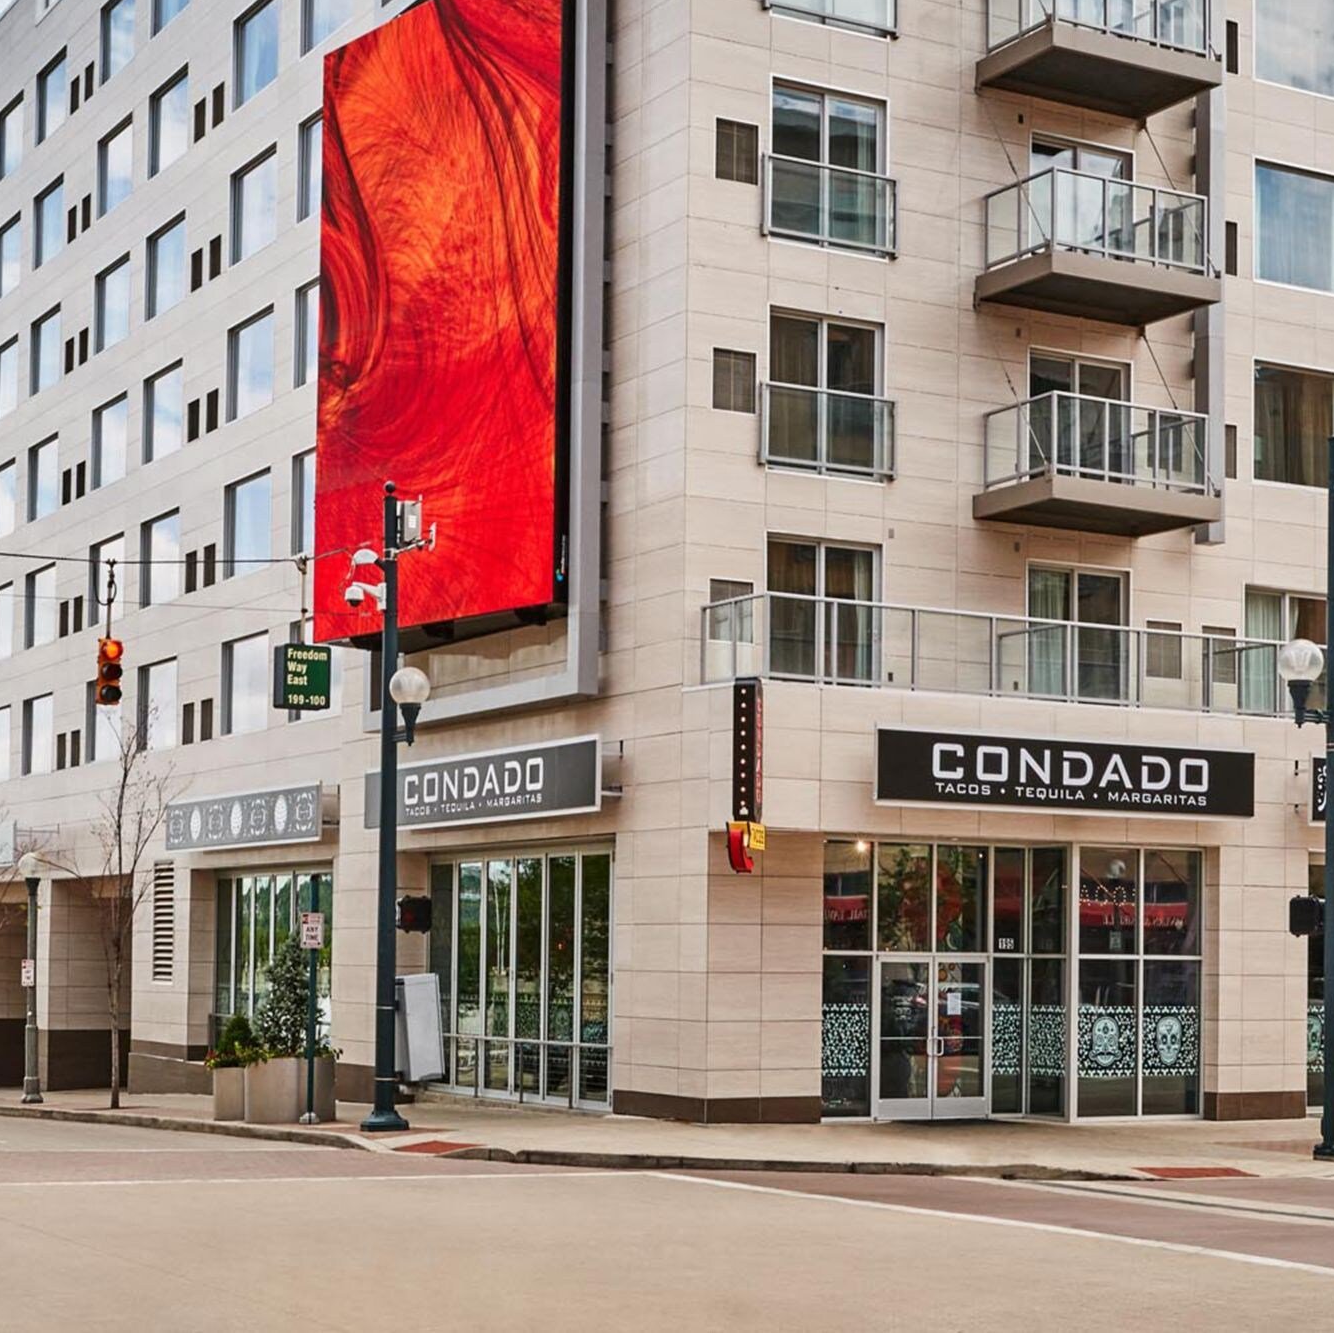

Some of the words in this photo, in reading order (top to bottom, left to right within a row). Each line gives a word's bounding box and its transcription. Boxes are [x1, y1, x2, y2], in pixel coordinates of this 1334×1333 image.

[287, 648, 328, 661] Freedom
[287, 661, 307, 674] Way
[287, 673, 308, 686] East
[288, 694, 326, 705] 199-100
[932, 742, 1209, 793] CONDADO
[404, 757, 544, 805] CONDADO
[935, 782, 991, 796] TACOS
[1015, 786, 1085, 801] TEQUILA
[1108, 791, 1207, 806] MARGARITAS
[405, 805, 430, 816] TACOS
[441, 801, 475, 814] TEQUILA
[486, 793, 542, 807] MARGARITAS
